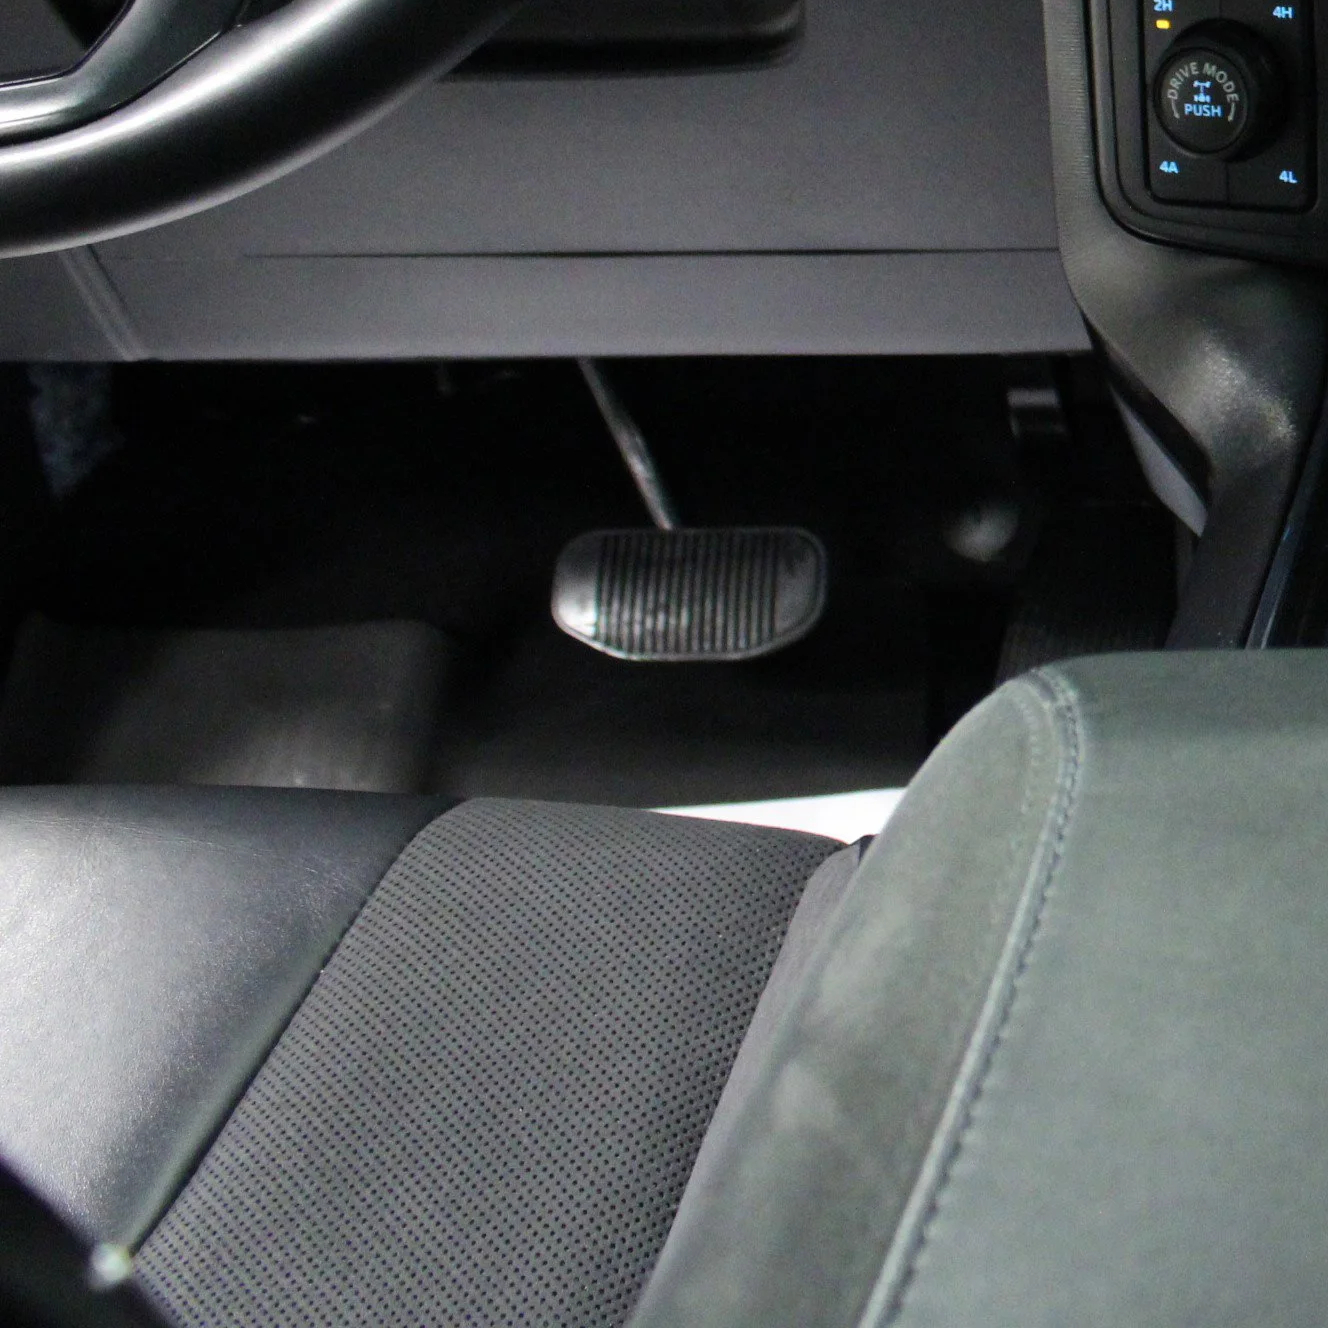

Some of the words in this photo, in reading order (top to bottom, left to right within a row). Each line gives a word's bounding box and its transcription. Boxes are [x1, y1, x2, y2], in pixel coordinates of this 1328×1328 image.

[1272, 5, 1294, 19] 4H
[1166, 61, 1200, 100] DRIVE
[1202, 61, 1240, 103] MODE
[1183, 102, 1224, 118] PUSH
[1158, 159, 1180, 174] 4A
[1278, 169, 1299, 184] 4L
